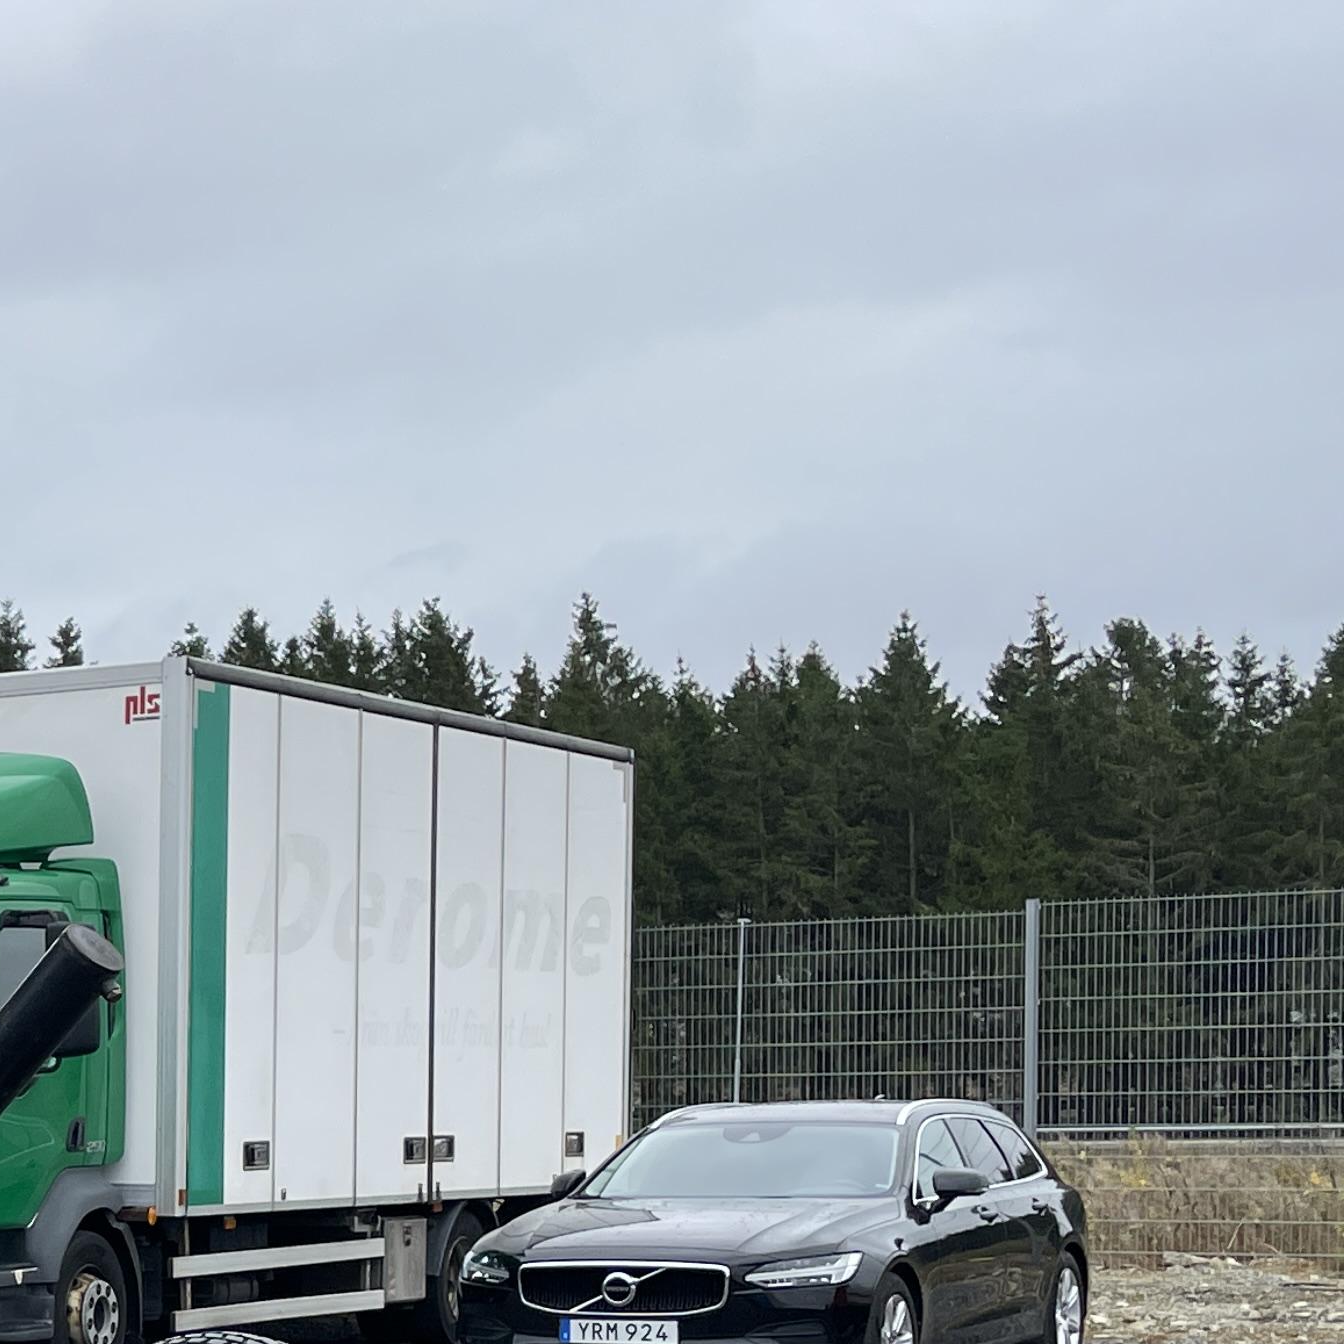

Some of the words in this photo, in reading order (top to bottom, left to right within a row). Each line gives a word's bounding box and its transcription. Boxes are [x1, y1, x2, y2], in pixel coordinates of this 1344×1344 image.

[125, 686, 160, 724] pls
[244, 833, 612, 977] Derome
[578, 1322, 618, 1341] YRM
[625, 1323, 668, 1342] 924
